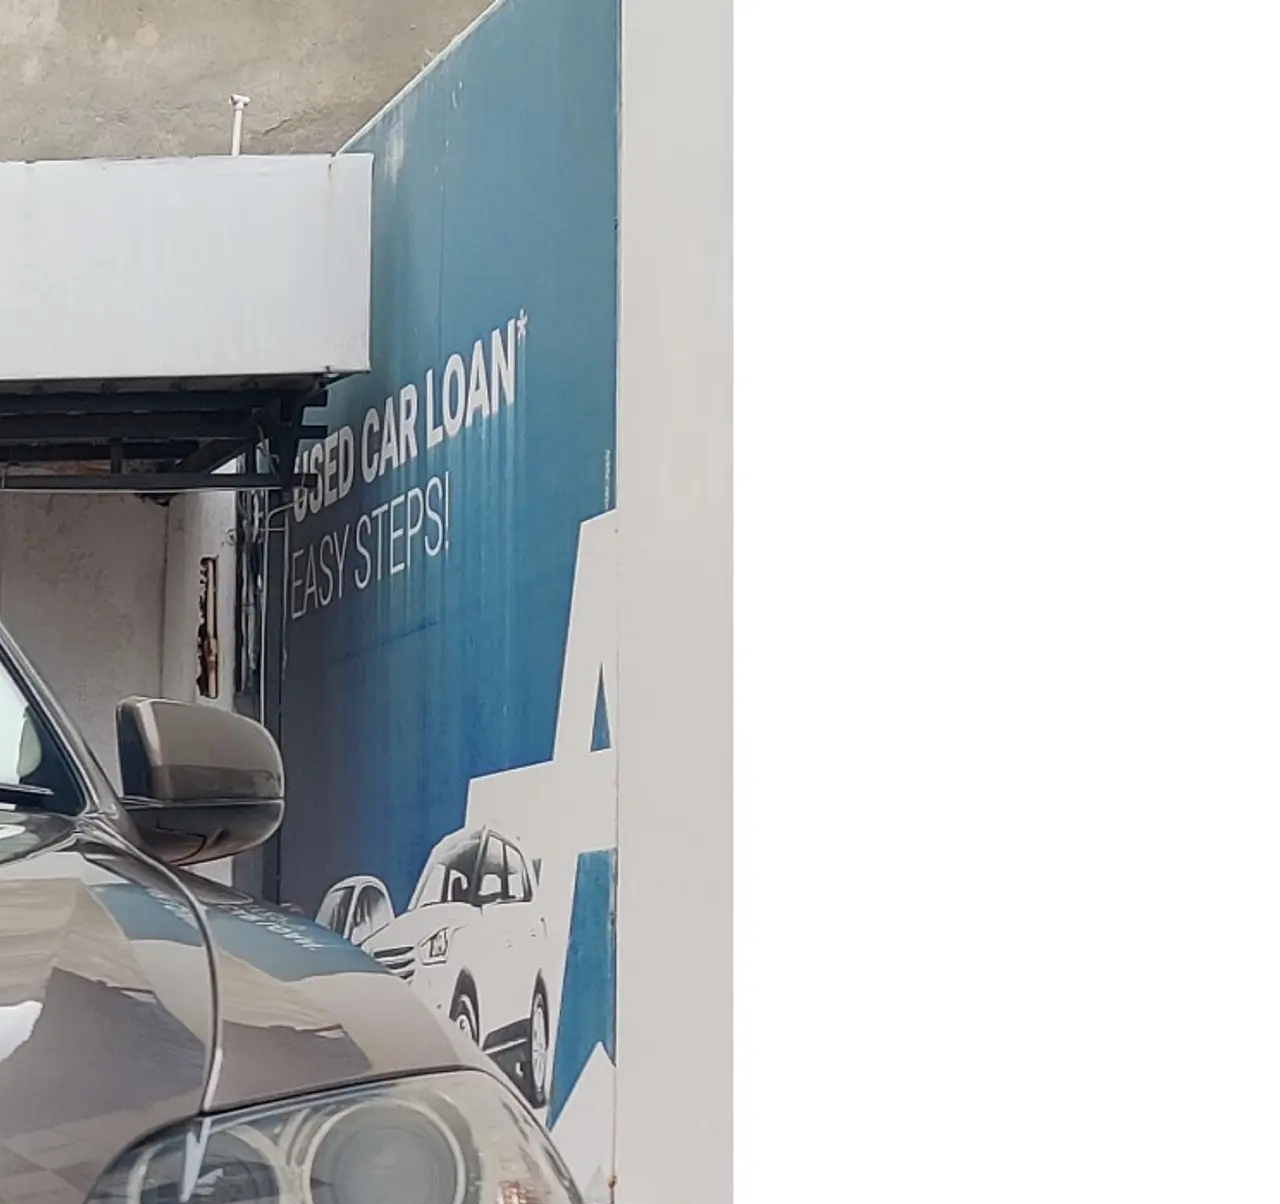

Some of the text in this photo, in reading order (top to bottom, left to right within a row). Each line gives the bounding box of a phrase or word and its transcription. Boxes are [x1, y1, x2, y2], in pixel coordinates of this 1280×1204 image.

[293, 425, 354, 522] USED
[361, 383, 418, 483] CAR
[291, 471, 450, 620] EASY STEPS!
